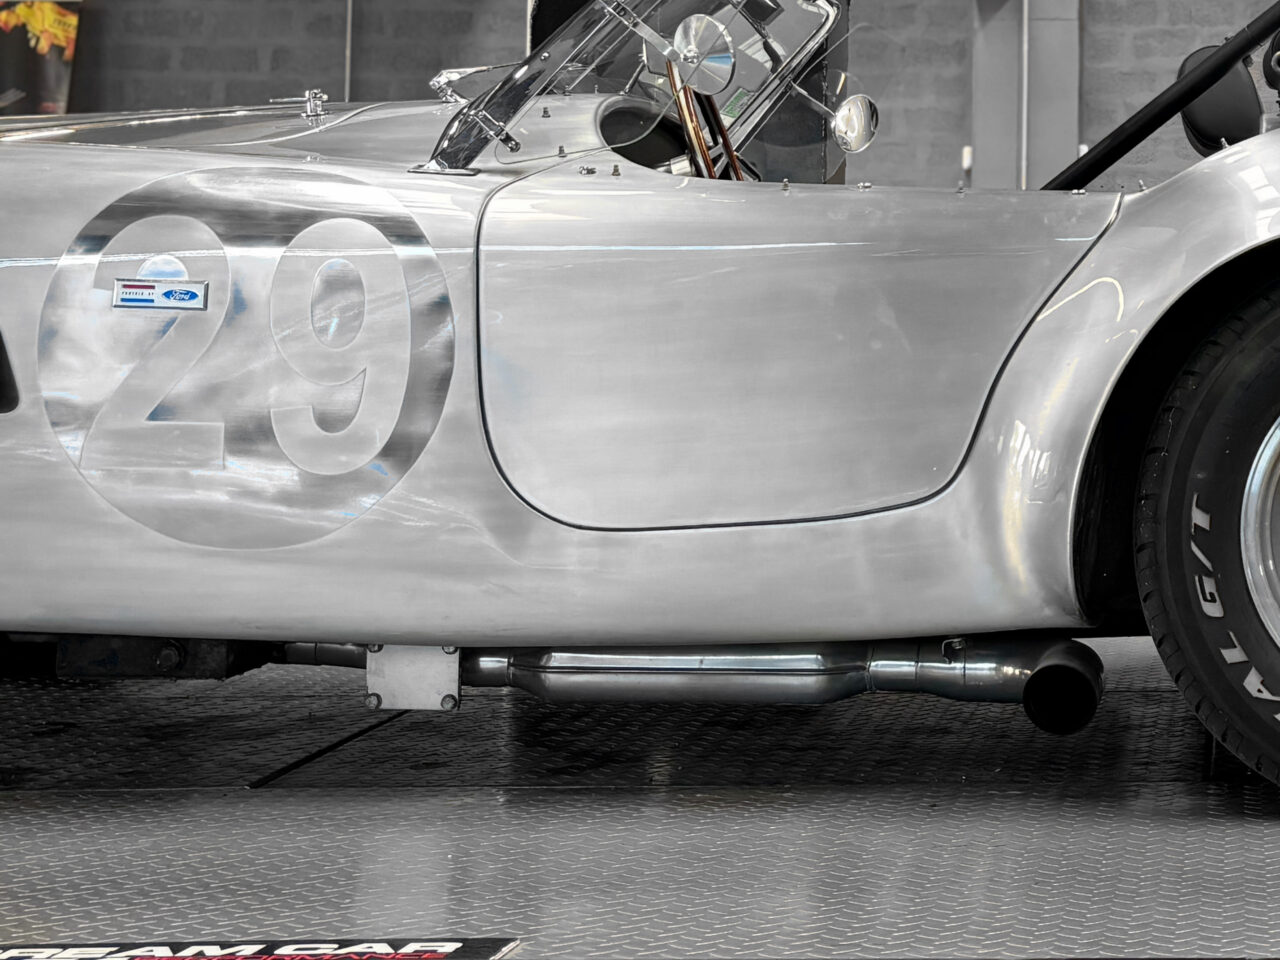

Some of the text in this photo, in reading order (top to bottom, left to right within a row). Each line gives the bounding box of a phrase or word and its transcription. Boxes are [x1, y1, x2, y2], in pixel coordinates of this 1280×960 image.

[168, 289, 192, 301] Ford
[80, 214, 411, 475] 29
[1190, 493, 1224, 617] G/T
[0, 941, 463, 959] REAM CAR
